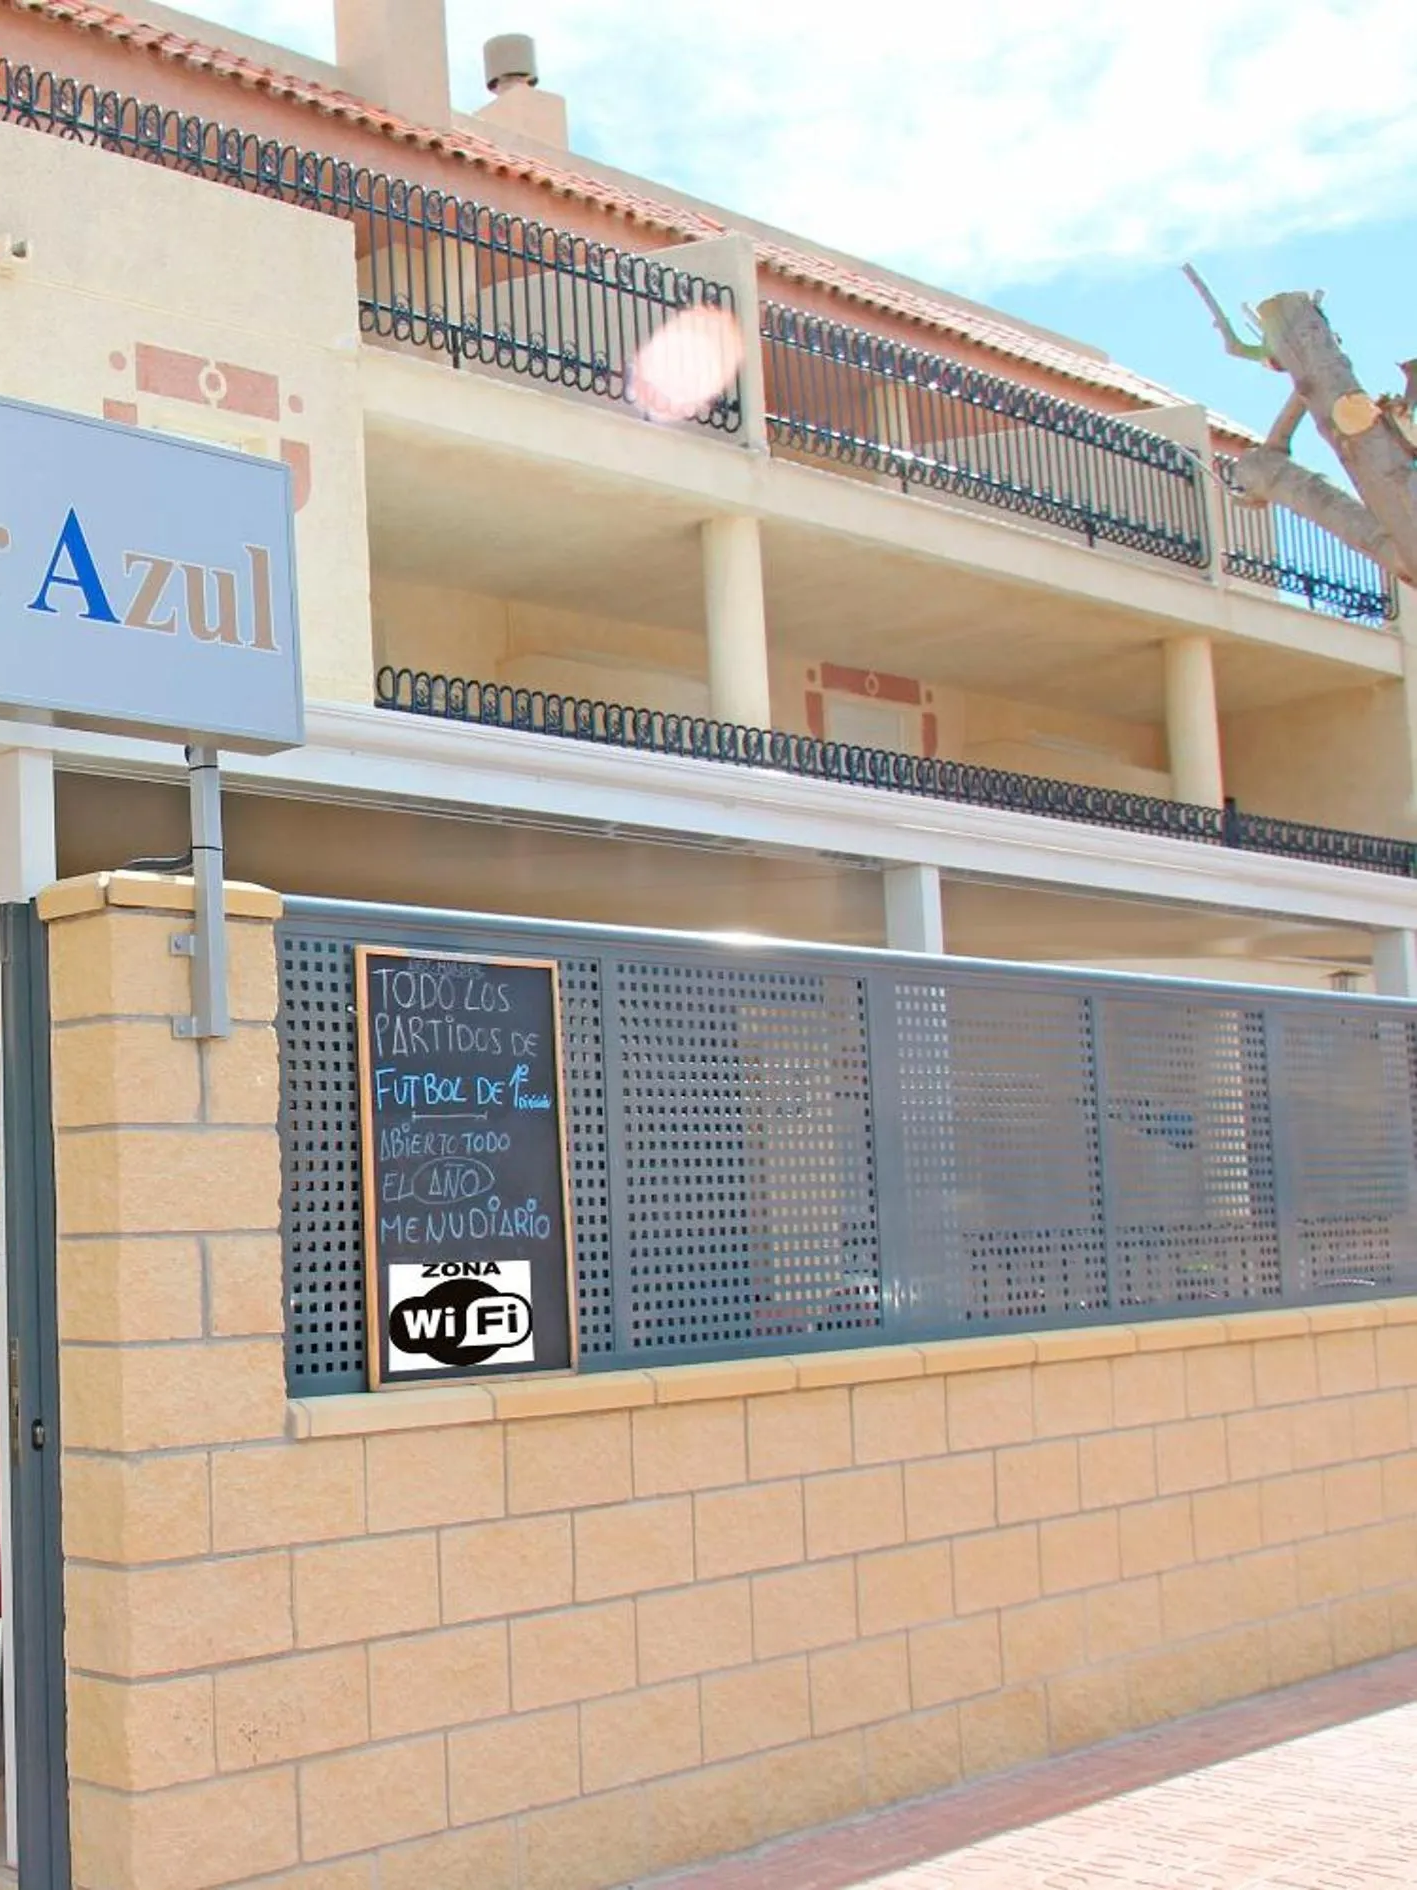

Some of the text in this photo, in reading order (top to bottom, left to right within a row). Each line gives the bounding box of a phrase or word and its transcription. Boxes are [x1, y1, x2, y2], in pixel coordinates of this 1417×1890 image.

[27, 505, 282, 654] Azul
[371, 968, 456, 1010] TODO
[464, 978, 510, 1012] LOS
[511, 1031, 540, 1057] DE
[375, 1067, 467, 1111] FUTBOL
[477, 1076, 505, 1105] DE
[462, 1131, 511, 1156] TODO
[382, 1162, 480, 1203] EL AÑO
[421, 1261, 501, 1278] ZONA
